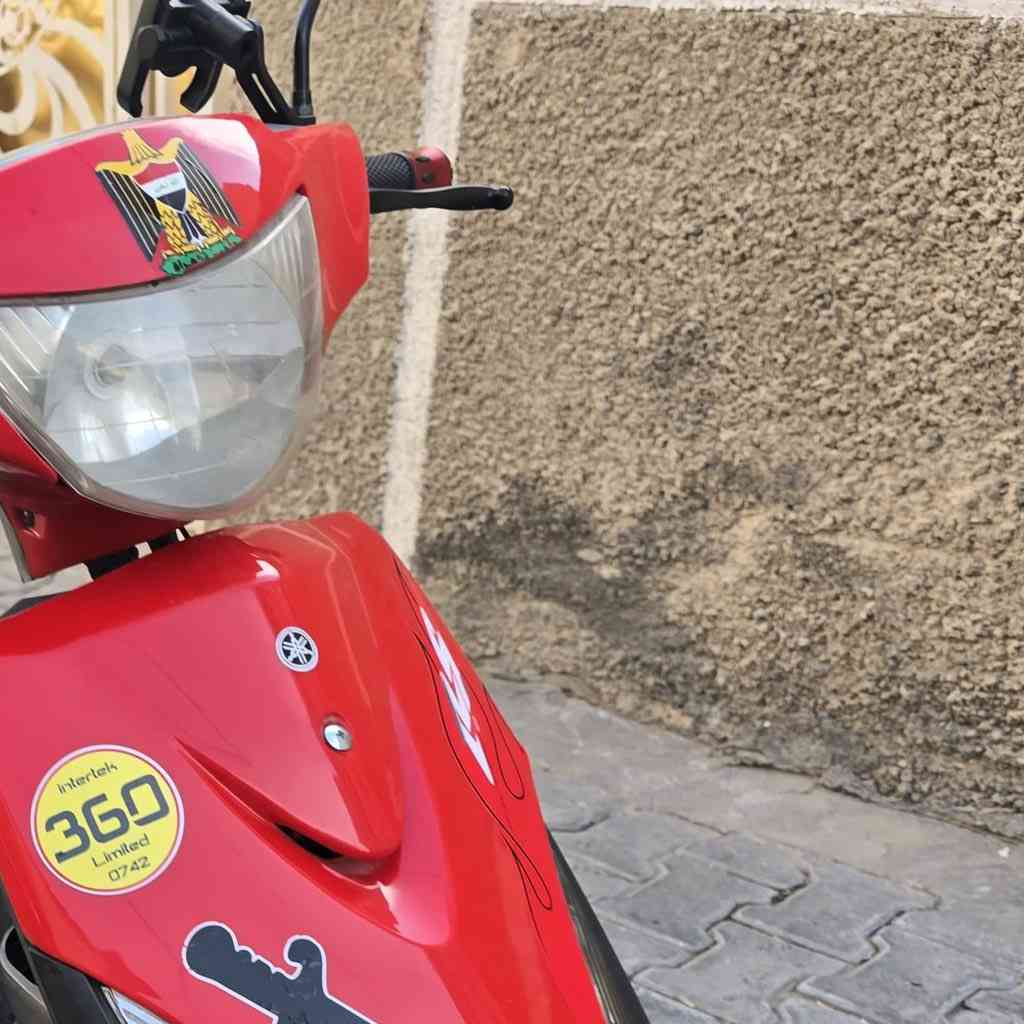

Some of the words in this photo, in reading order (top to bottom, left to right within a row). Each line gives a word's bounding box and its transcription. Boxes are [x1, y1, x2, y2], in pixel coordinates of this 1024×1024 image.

[45, 774, 170, 864] 360
[92, 833, 150, 868] Limited
[108, 856, 151, 882] 0742
